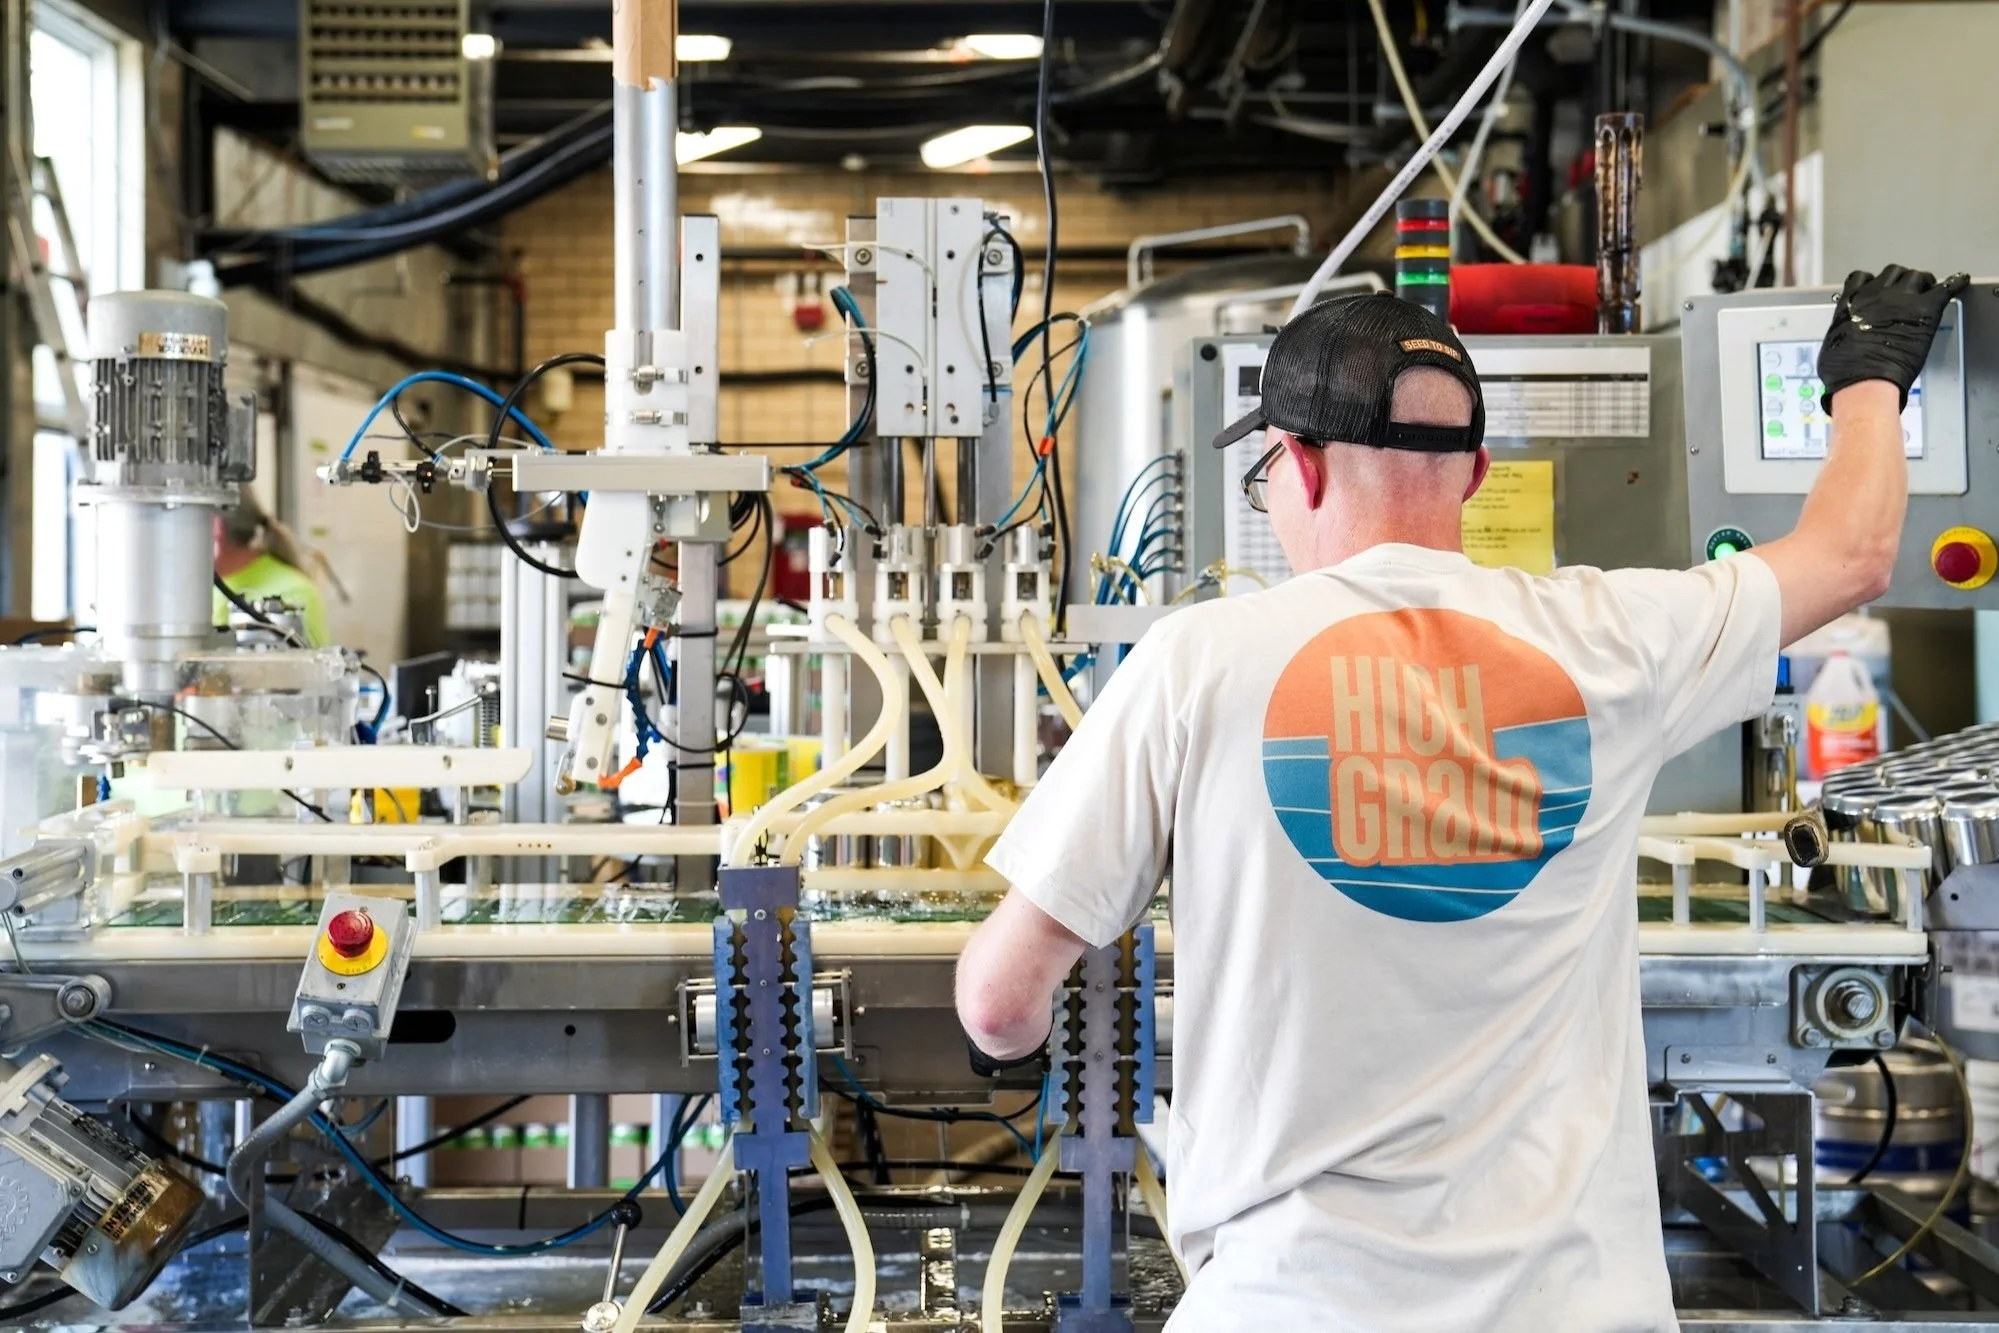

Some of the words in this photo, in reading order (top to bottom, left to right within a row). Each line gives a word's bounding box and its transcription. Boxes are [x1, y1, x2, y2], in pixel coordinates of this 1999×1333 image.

[1404, 339, 1430, 350] SEED
[1430, 341, 1443, 351] TO
[1444, 345, 1459, 358] SIP
[1330, 655, 1490, 760] HIGH
[102, 1180, 151, 1233] INVERTER
[112, 1217, 132, 1239] DUTY
[130, 1192, 154, 1218] MOTOR
